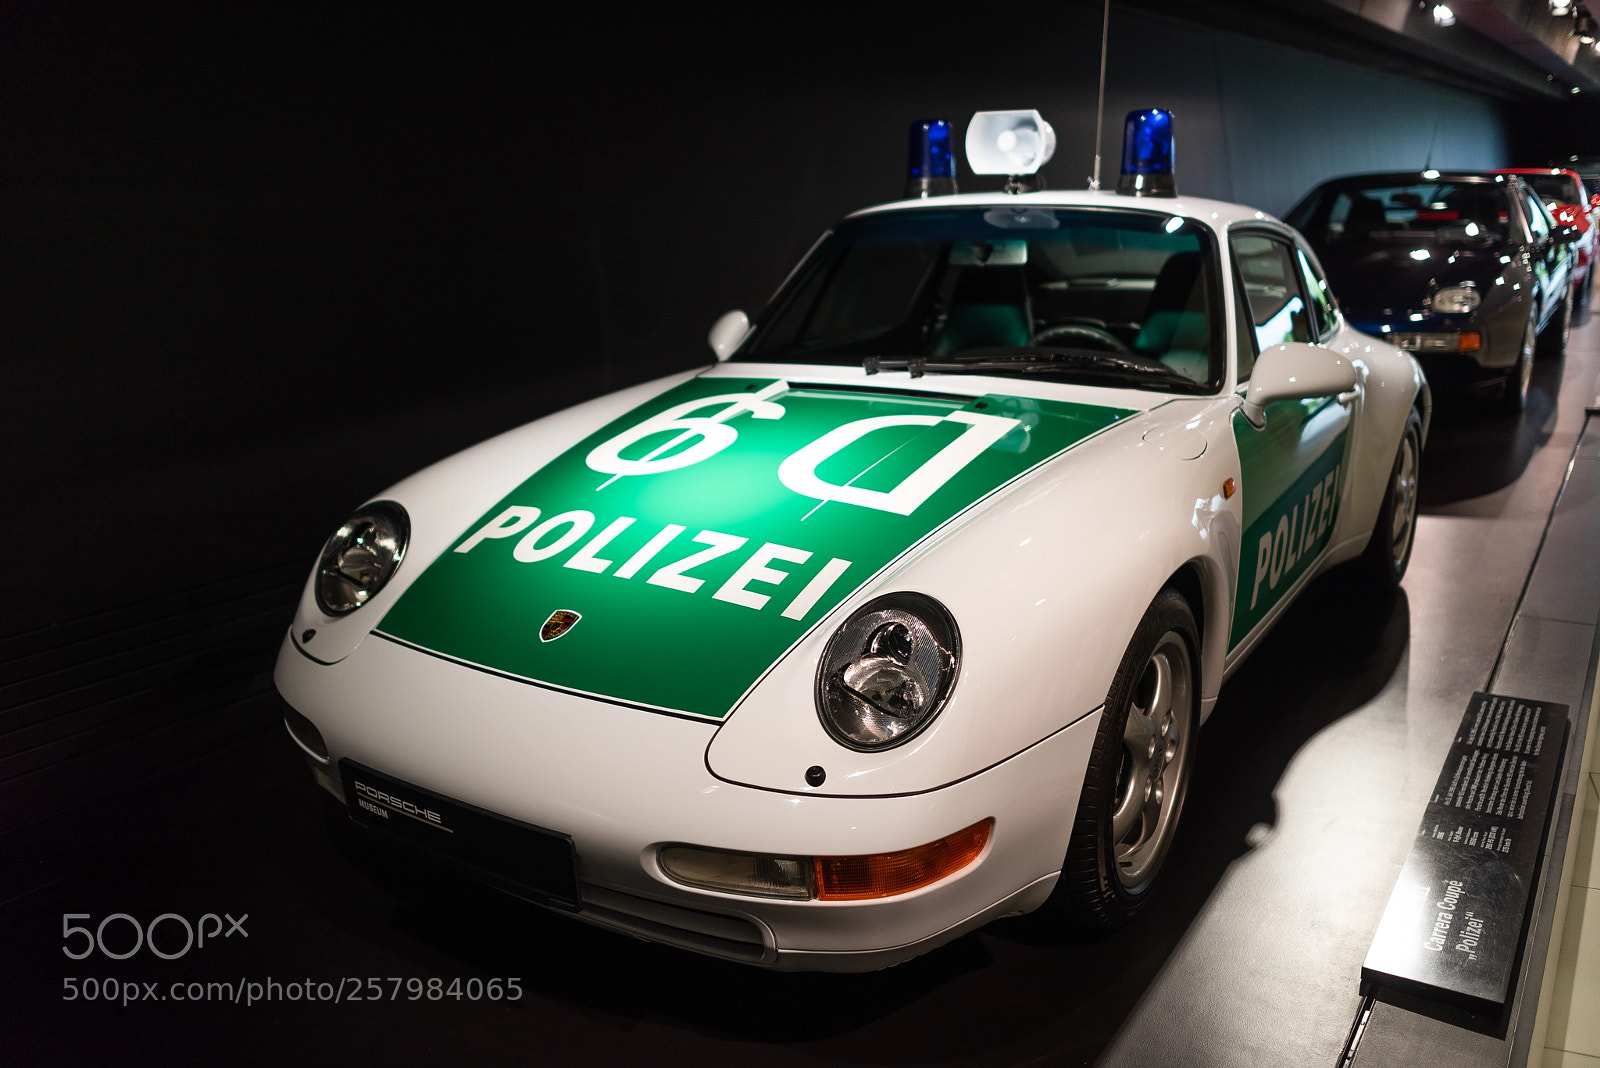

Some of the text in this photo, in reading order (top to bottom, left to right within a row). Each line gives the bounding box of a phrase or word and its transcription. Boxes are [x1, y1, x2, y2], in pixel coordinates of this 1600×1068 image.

[453, 504, 854, 622] POLIZEI
[1249, 463, 1341, 612] POLIZEI
[354, 780, 442, 824] PORSCHE
[358, 798, 389, 820] MUSEUM
[1423, 879, 1466, 952] Carrera Coupé
